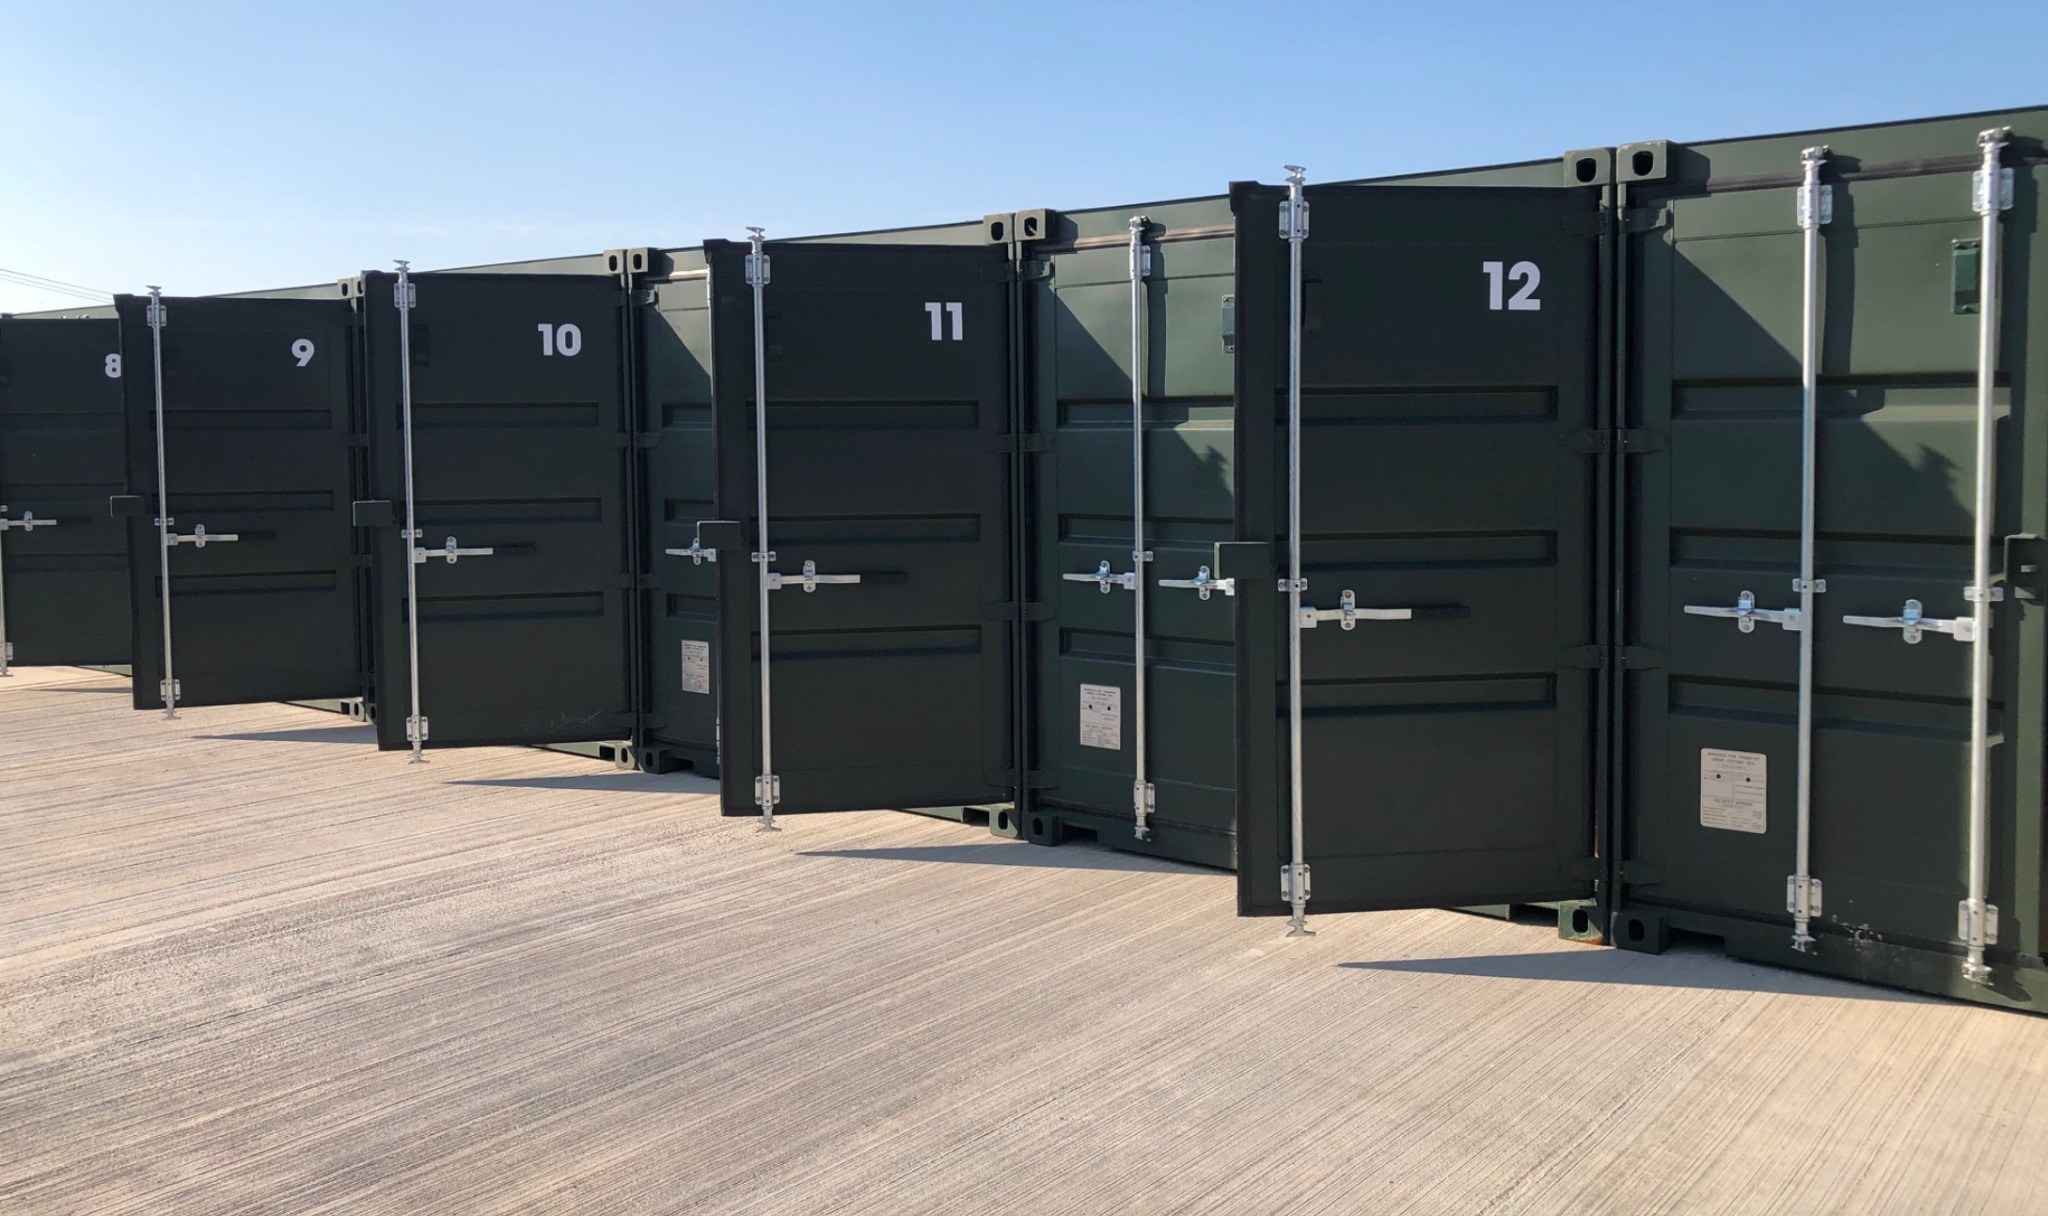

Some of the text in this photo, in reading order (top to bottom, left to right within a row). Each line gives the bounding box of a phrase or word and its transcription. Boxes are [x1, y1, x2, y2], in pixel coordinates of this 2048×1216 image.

[1482, 261, 1541, 311] 12
[924, 302, 963, 341] 11
[291, 338, 315, 367] 9
[537, 323, 582, 357] 10
[104, 353, 121, 378] 8
